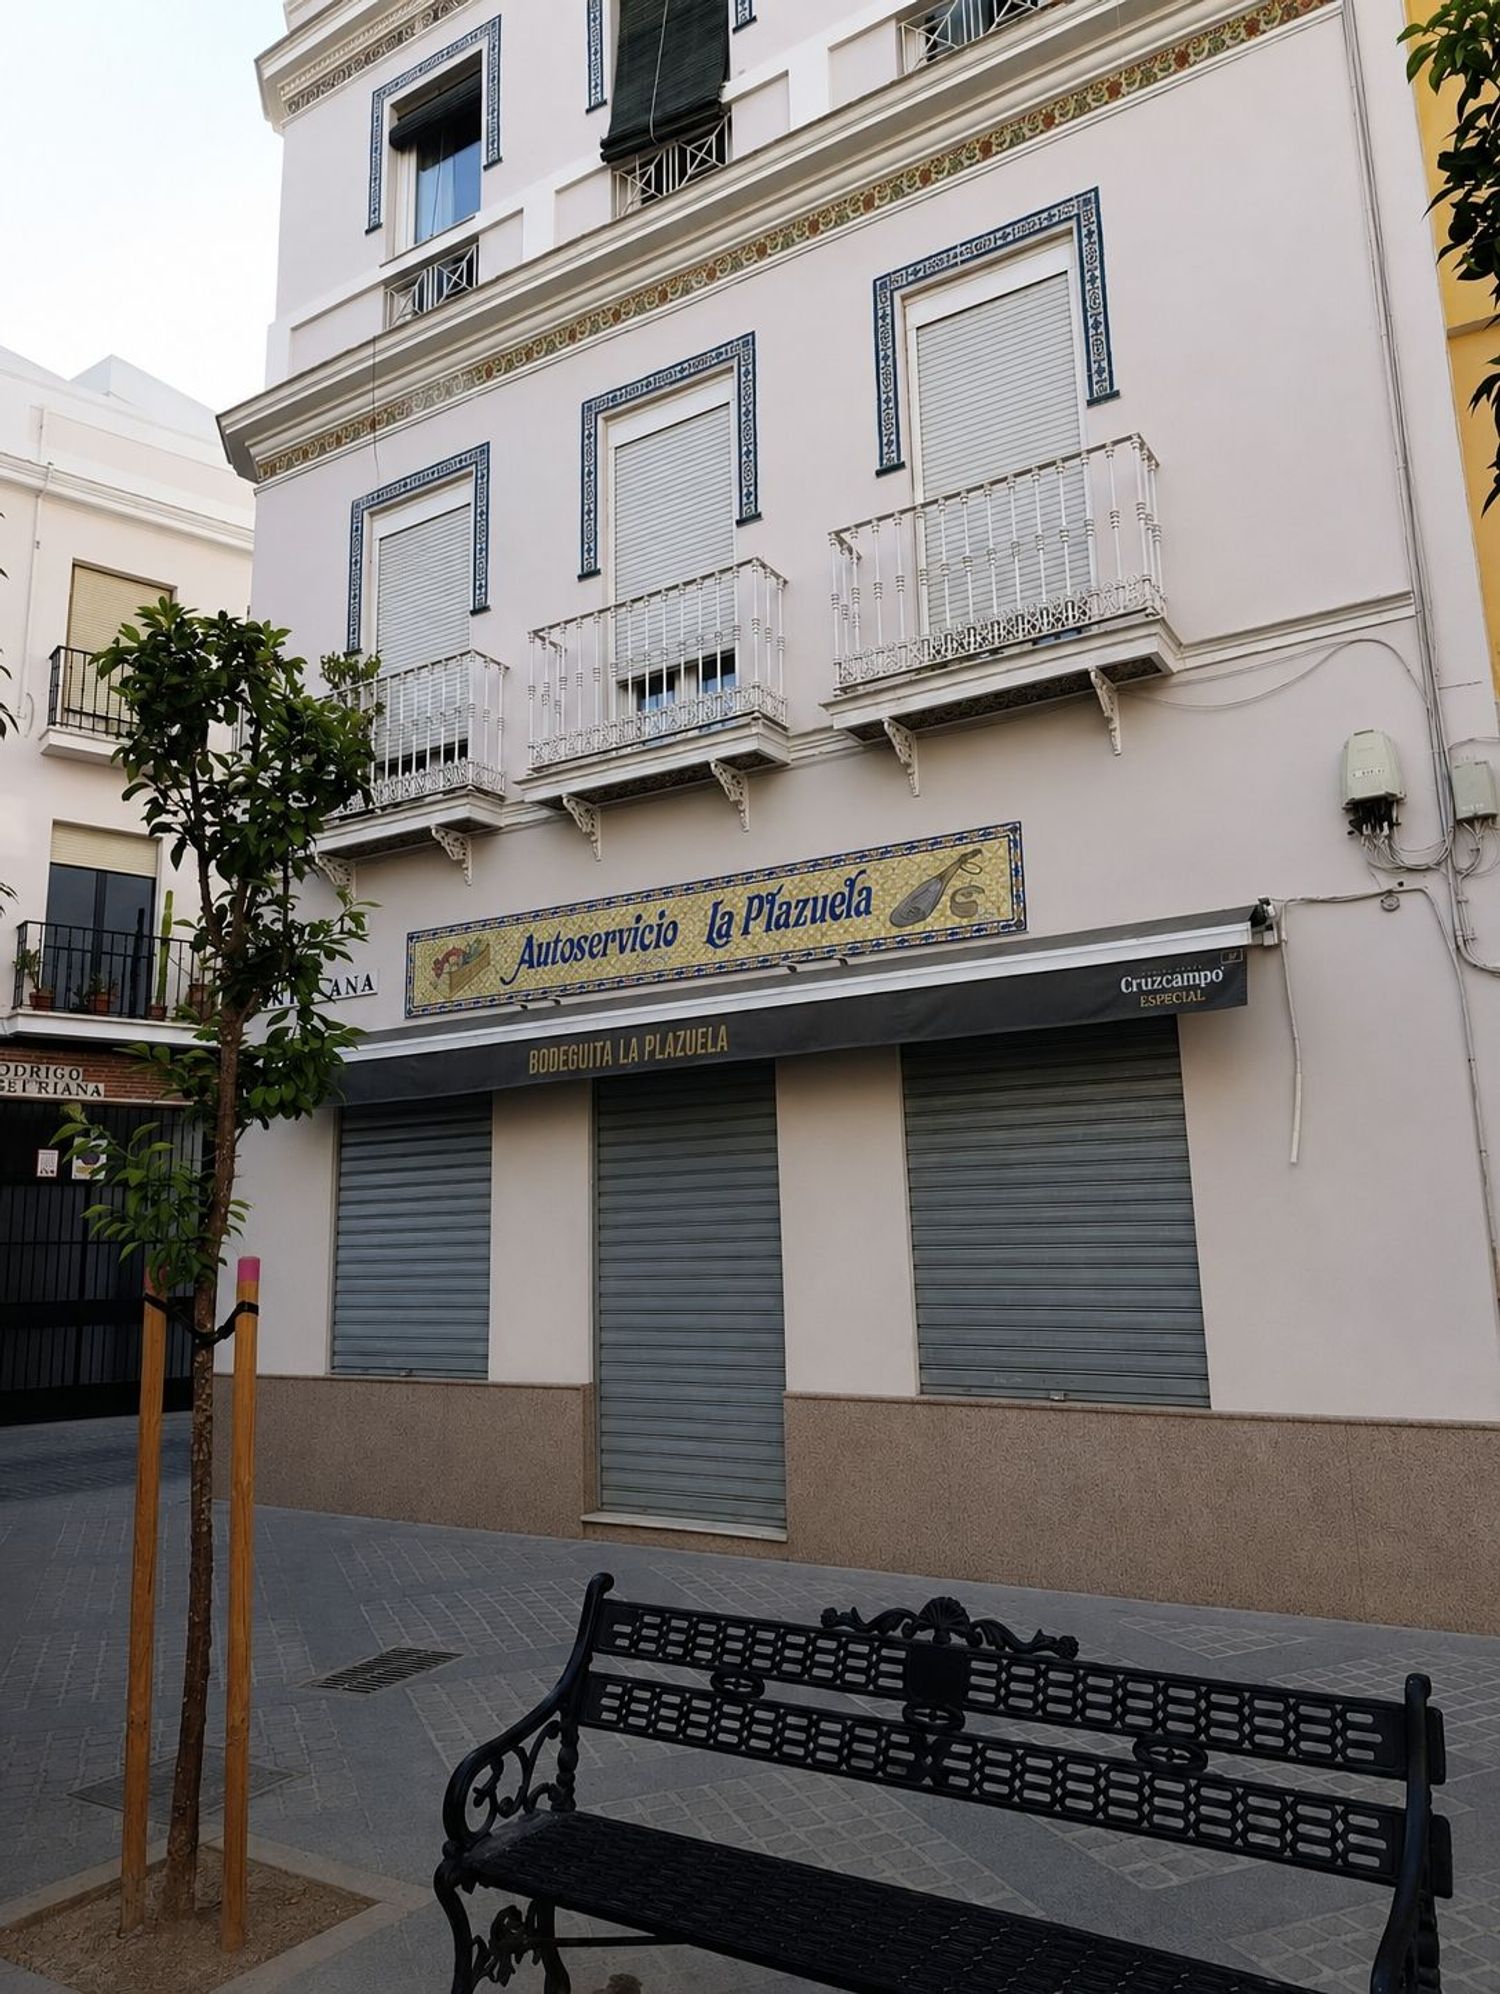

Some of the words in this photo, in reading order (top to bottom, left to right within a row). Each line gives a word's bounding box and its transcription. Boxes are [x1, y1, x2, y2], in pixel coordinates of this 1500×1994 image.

[500, 909, 679, 986] Autoservicio
[740, 868, 873, 937] Plazuela
[1120, 966, 1224, 994] Cruzcampo
[1140, 989, 1206, 1008] ESPECIAL
[529, 1040, 612, 1074] BODEGUITA
[619, 1037, 639, 1064] LA
[644, 1025, 728, 1061] PLAZUELA
